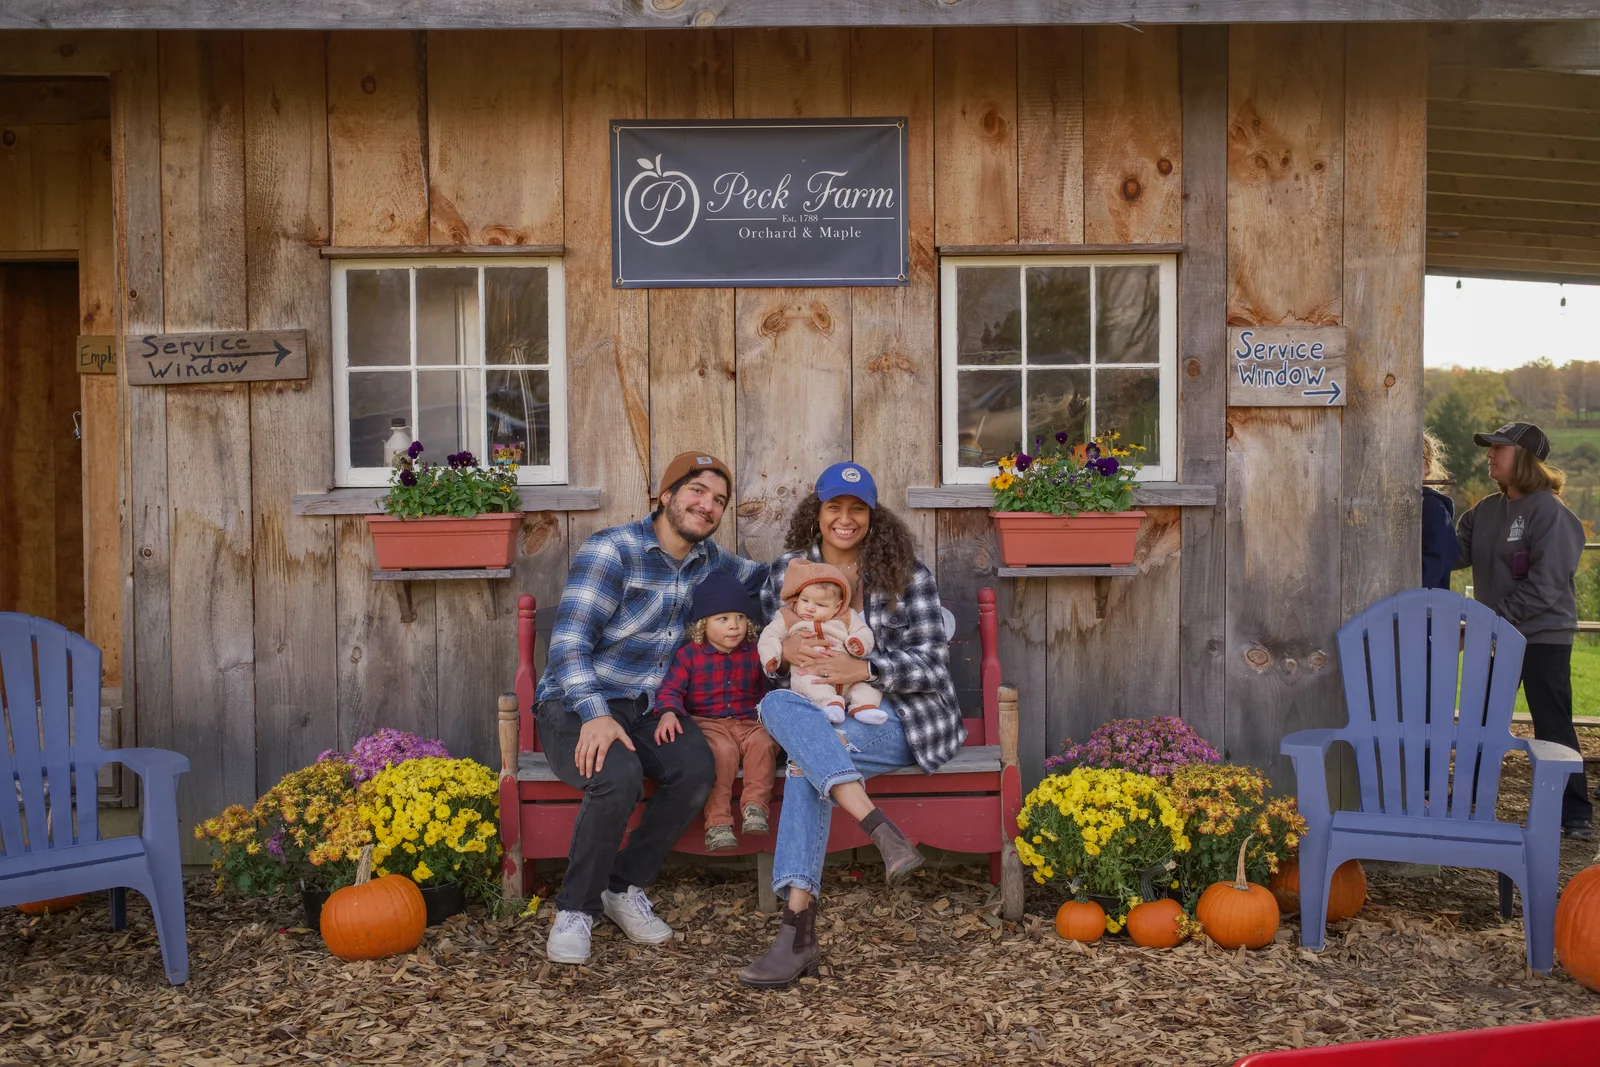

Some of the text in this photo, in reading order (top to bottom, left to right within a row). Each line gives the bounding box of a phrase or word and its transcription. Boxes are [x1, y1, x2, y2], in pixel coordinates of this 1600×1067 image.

[706, 170, 894, 213] Peck Farm
[782, 214, 819, 223] Est. 1788
[738, 226, 862, 240] Orchard & Maple
[142, 335, 250, 358] Service
[1235, 331, 1324, 360] Service
[147, 359, 248, 378] Window
[1238, 360, 1326, 387] Window
